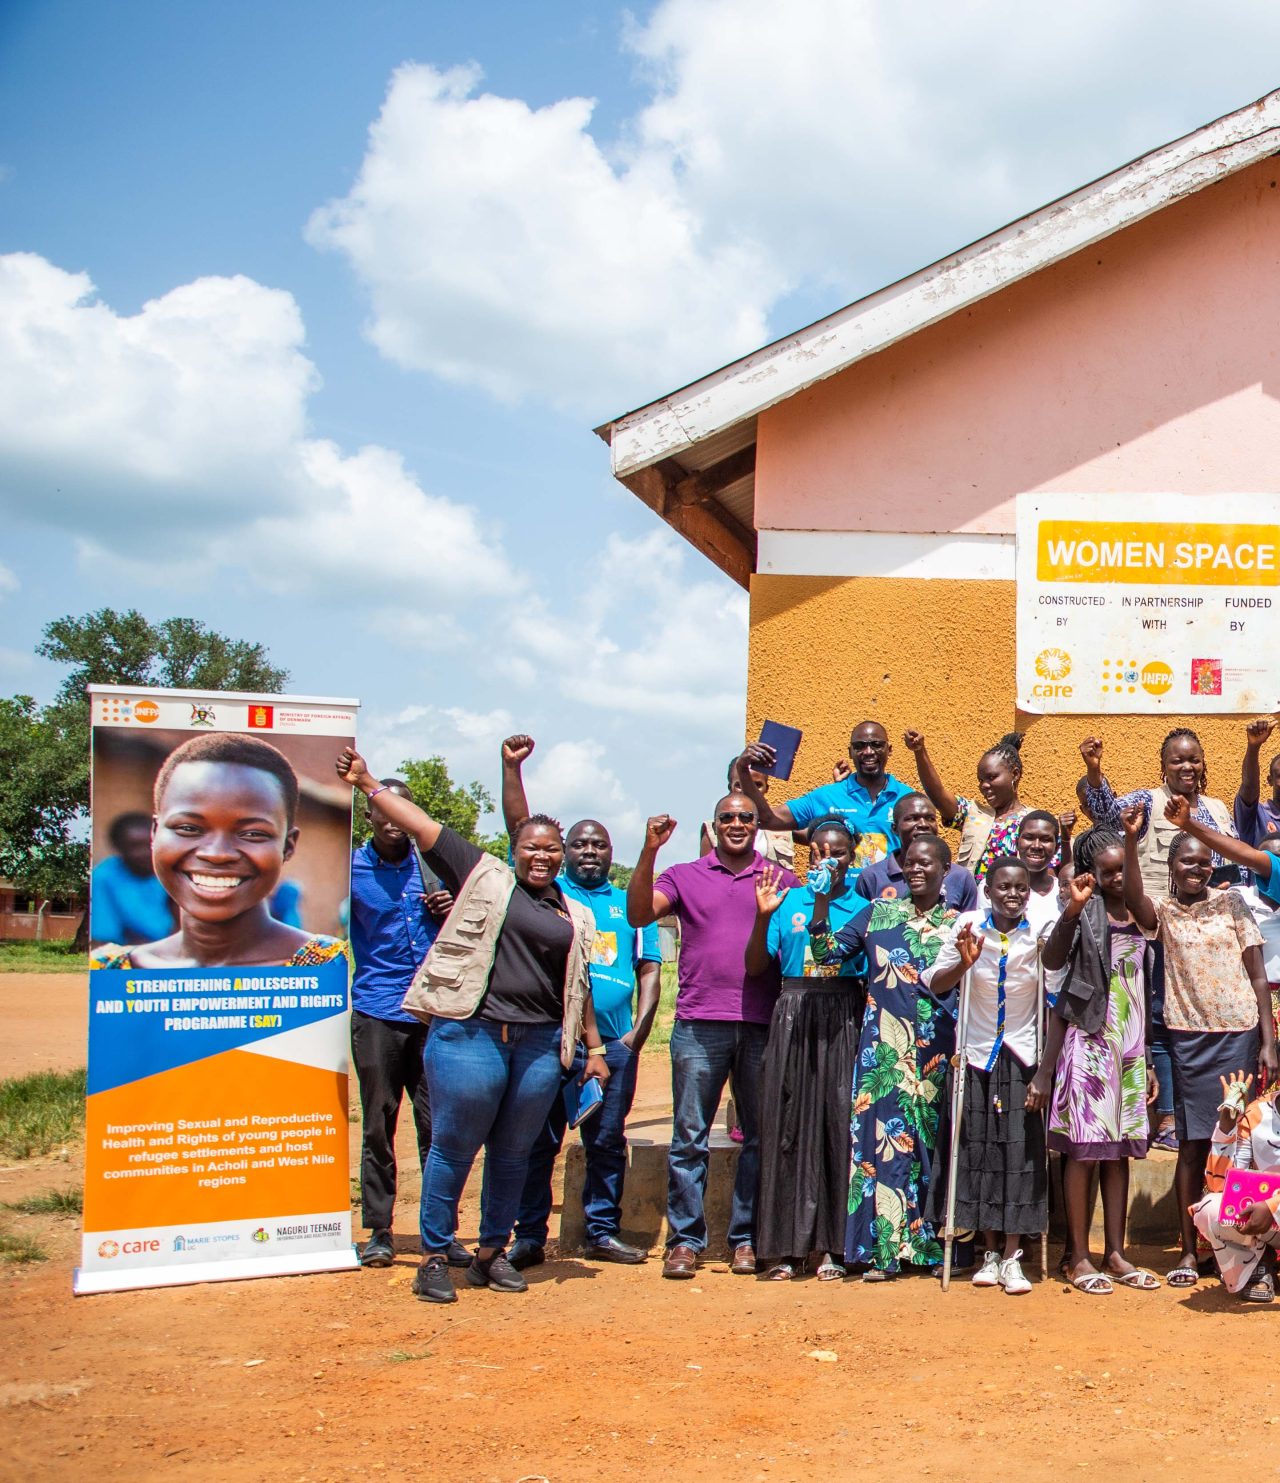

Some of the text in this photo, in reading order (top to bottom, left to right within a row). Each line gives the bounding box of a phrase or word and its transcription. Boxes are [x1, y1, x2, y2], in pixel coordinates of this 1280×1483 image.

[1048, 540, 1275, 570] WOMEN SPACE
[1038, 595, 1106, 606] CONSTRUCTED
[1122, 596, 1204, 608] IN PARTNERSHIP
[1225, 597, 1272, 609] FUNDED
[1056, 617, 1068, 627] BY
[1142, 619, 1167, 630] WITH
[1230, 621, 1245, 632] BY
[1032, 684, 1073, 698] care
[126, 977, 318, 994] STRENGTHENING ADOLESCENTS
[96, 994, 343, 1013] AND YOUTH EMPOWERMENT AND RIGHTS
[164, 1014, 282, 1031] PROGRAMME (SAY)
[106, 1112, 333, 1136] Improving Sexual and Reproductive
[102, 1125, 336, 1150] Health and Rights of young people in
[128, 1141, 313, 1163] refugee settlements and host
[103, 1154, 335, 1179] communities in Acholi and West Nile
[198, 1174, 247, 1189] regions
[276, 1222, 342, 1236] NAGURU TEENAGE
[212, 1234, 240, 1242] STOPES
[122, 1239, 160, 1254] care
